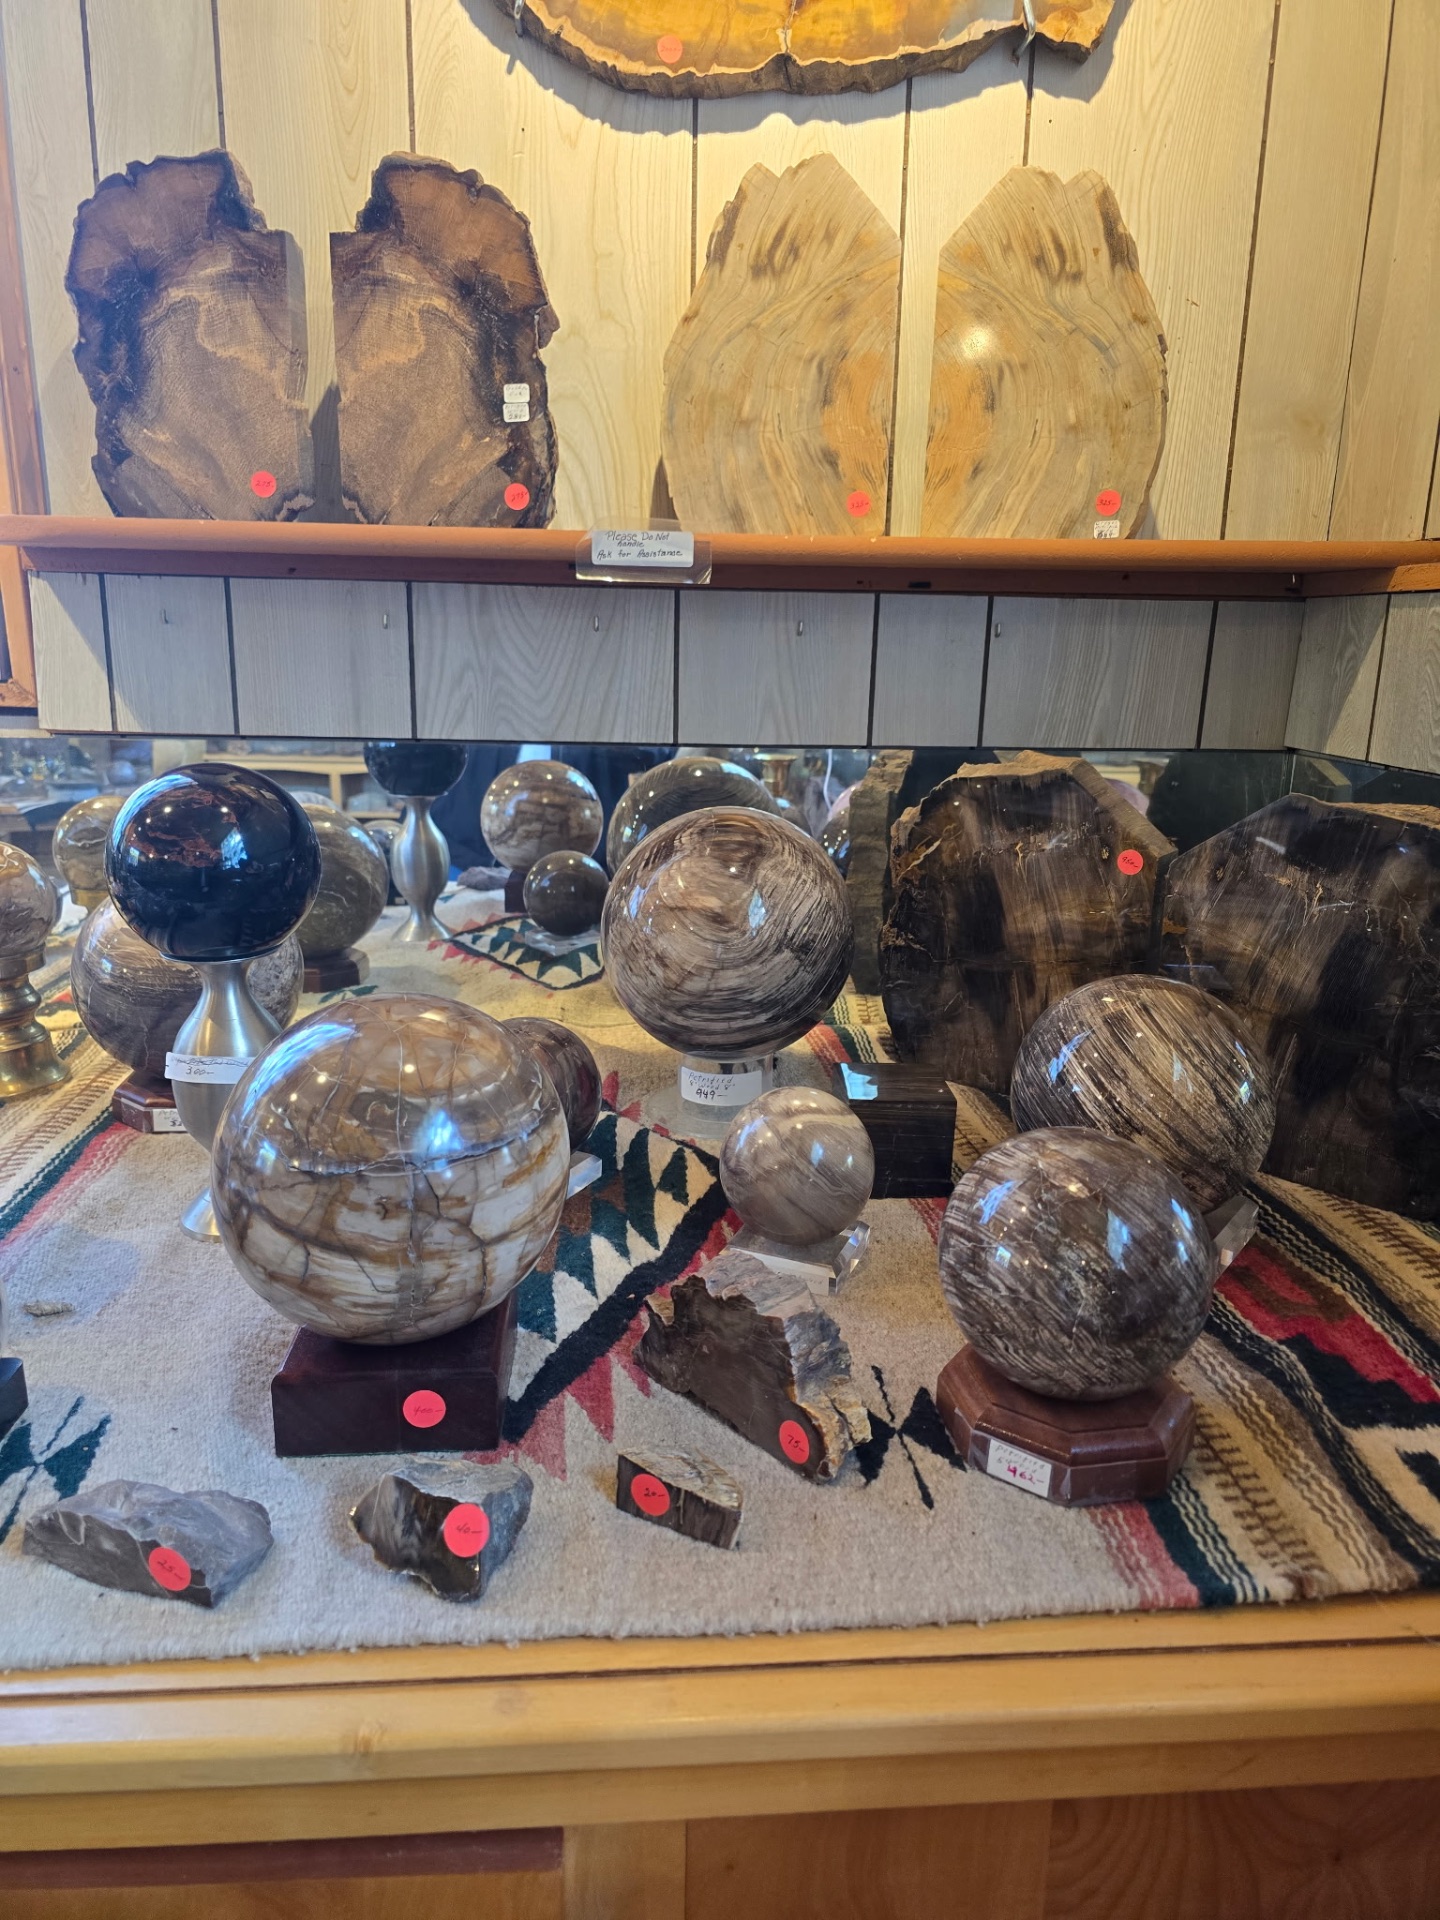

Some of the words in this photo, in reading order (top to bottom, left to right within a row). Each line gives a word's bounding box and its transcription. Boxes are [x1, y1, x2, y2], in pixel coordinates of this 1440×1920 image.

[606, 530, 638, 542] Please
[641, 532, 654, 541] Do
[655, 532, 670, 541] Not
[597, 550, 612, 560] Ask
[618, 549, 632, 558] for
